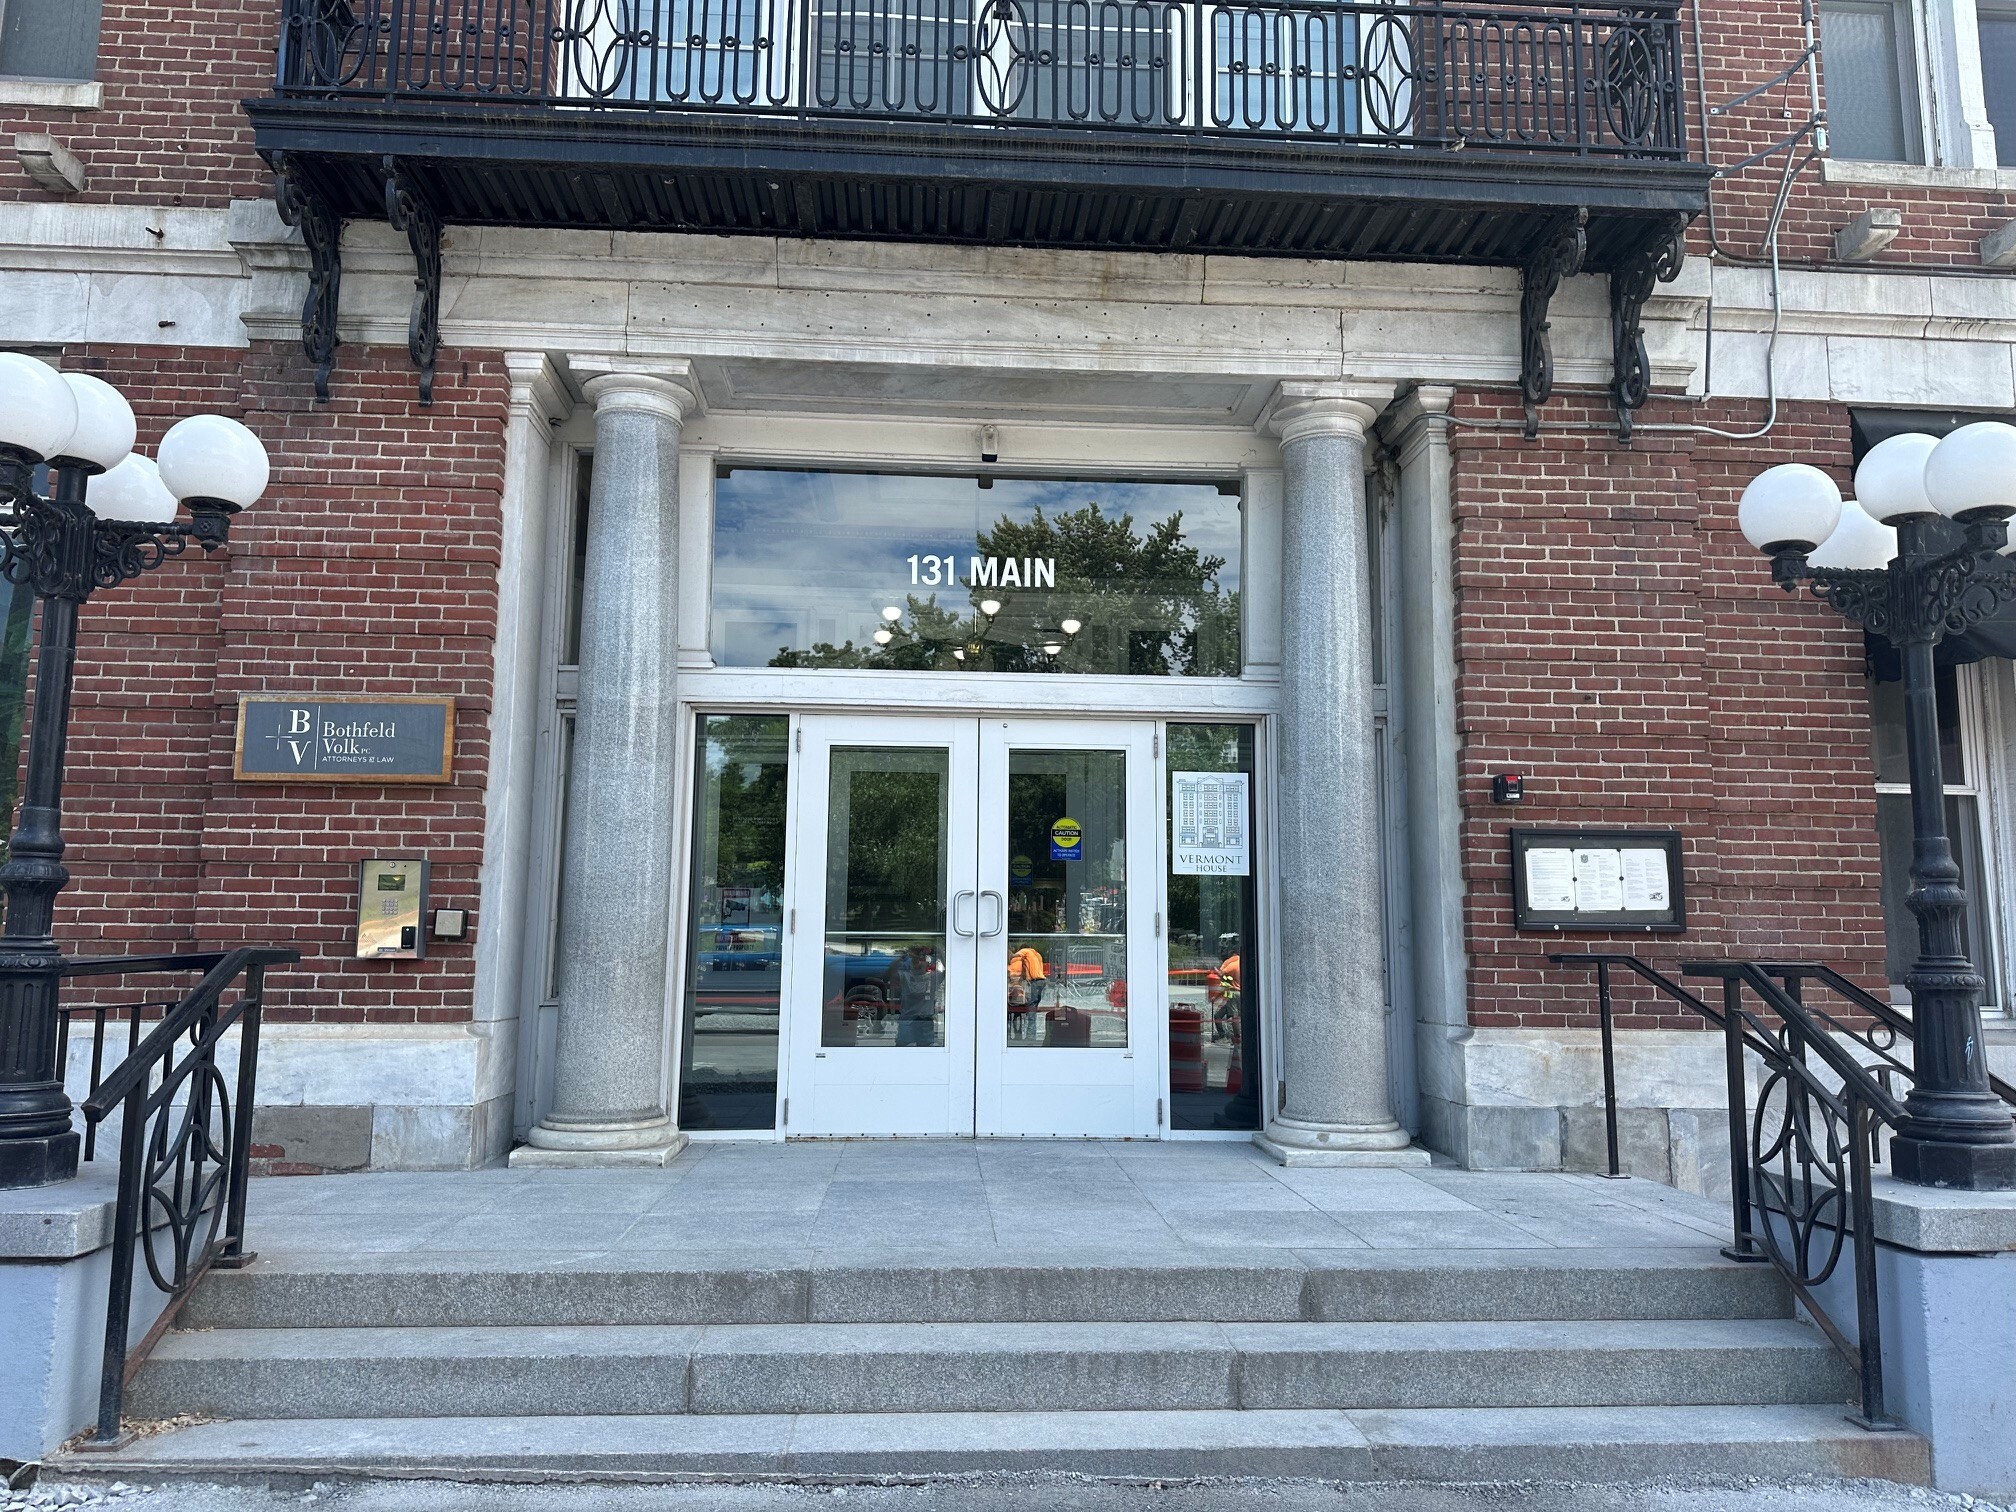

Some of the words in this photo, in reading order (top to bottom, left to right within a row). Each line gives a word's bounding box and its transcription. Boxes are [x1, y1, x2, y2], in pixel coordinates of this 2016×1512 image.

[907, 554, 955, 586] 131
[970, 556, 1055, 588] MAIN
[288, 709, 311, 734] B
[323, 721, 396, 738] Bothfeld
[288, 740, 312, 765] V
[323, 739, 360, 754] Volk
[1180, 855, 1242, 864] VERMONT
